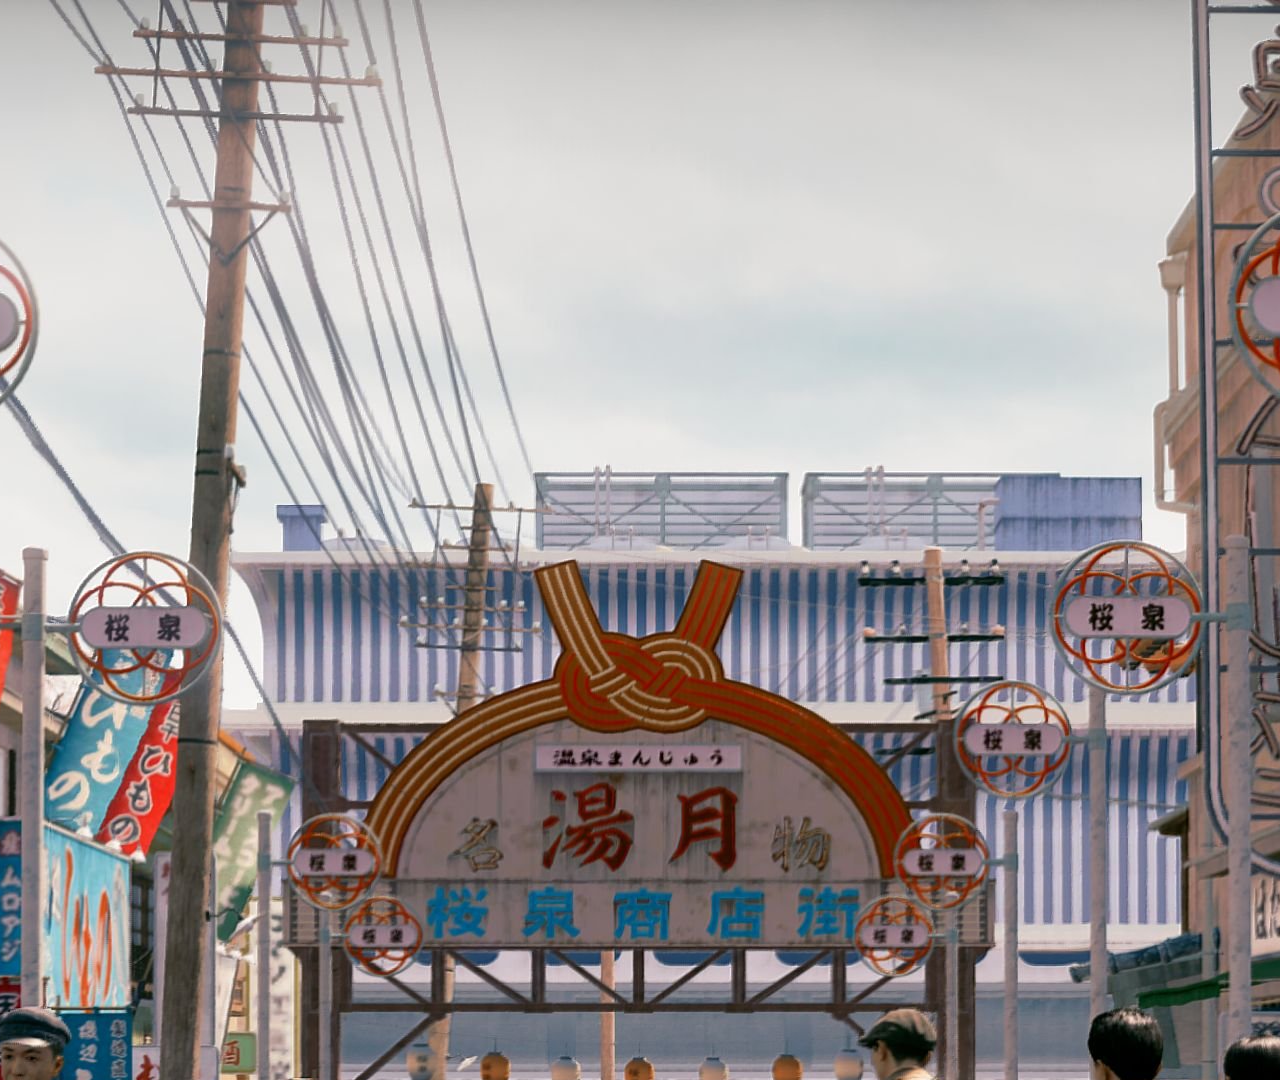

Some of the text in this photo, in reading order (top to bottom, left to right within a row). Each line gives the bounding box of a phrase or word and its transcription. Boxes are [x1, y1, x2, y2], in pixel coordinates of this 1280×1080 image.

[105, 612, 182, 643] 桜泉
[1089, 603, 1166, 633] 桜泉
[983, 728, 1042, 752] 桜泉
[553, 748, 724, 767] 温泉まんじゅう
[108, 744, 172, 844] ひもの
[455, 815, 506, 873] 名
[541, 784, 740, 873] 湯月
[772, 815, 833, 873] 物
[308, 853, 357, 872] 桜泉
[917, 853, 968, 873] 桜泉
[426, 886, 860, 942] 桜泉商店街
